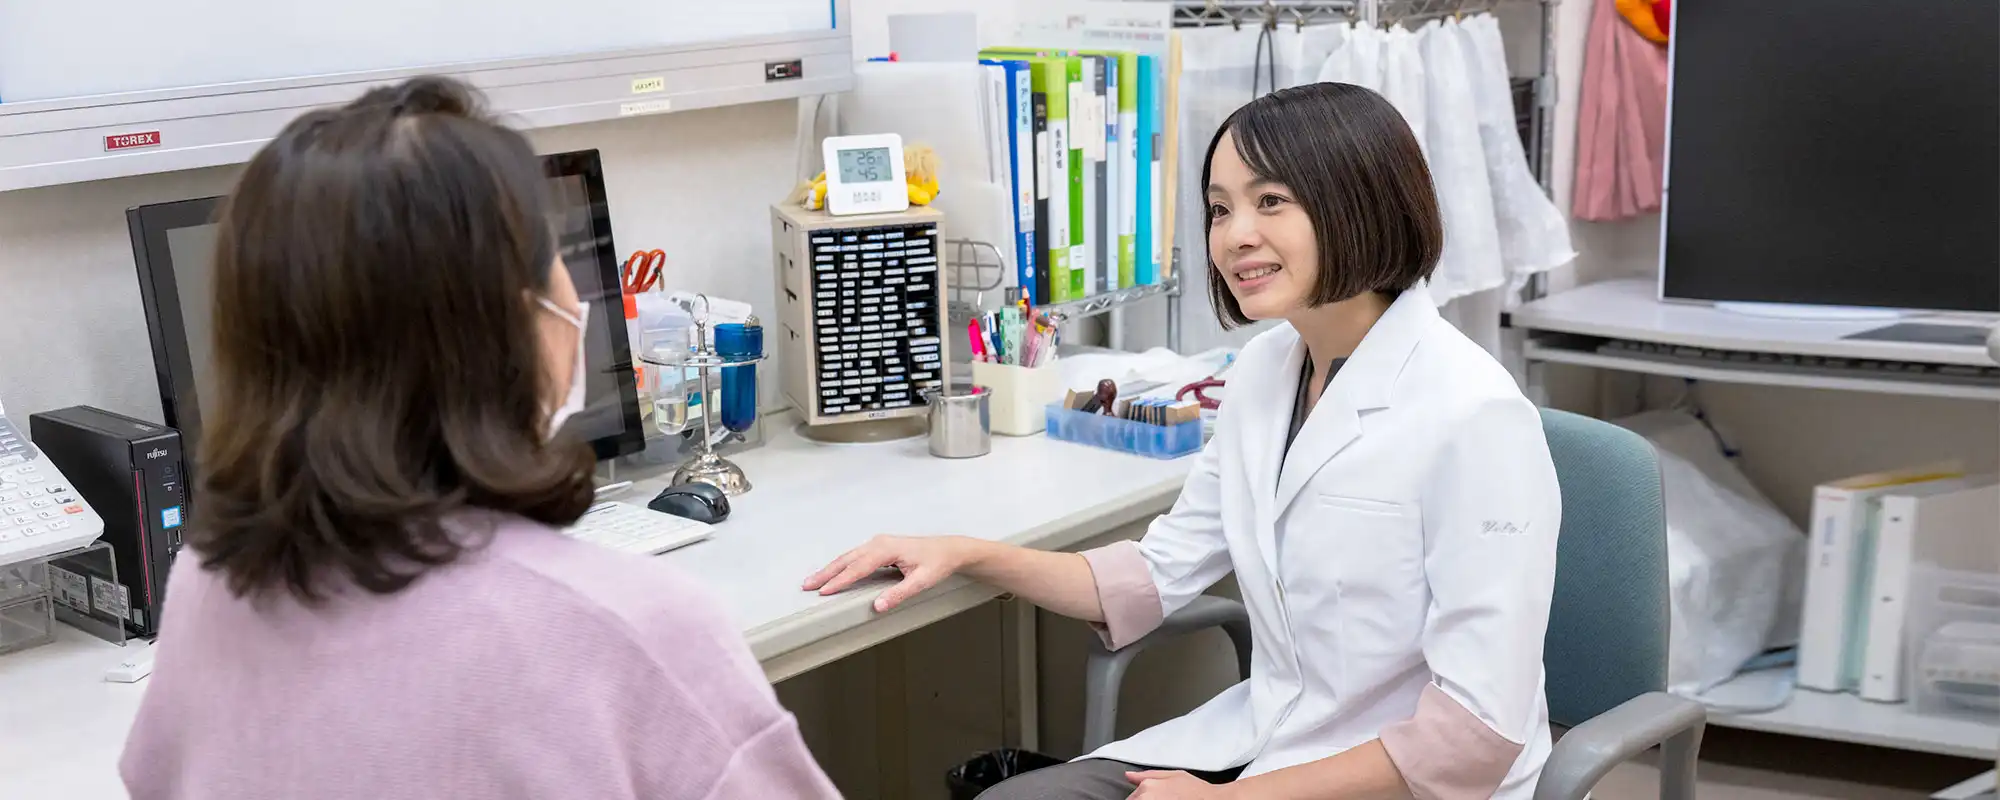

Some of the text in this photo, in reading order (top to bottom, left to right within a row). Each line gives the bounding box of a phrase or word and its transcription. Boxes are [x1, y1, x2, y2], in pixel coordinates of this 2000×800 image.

[113, 133, 154, 147] TOREX
[857, 151, 876, 165] 26
[858, 166, 878, 180] 45
[146, 448, 168, 460] FUJITSU
